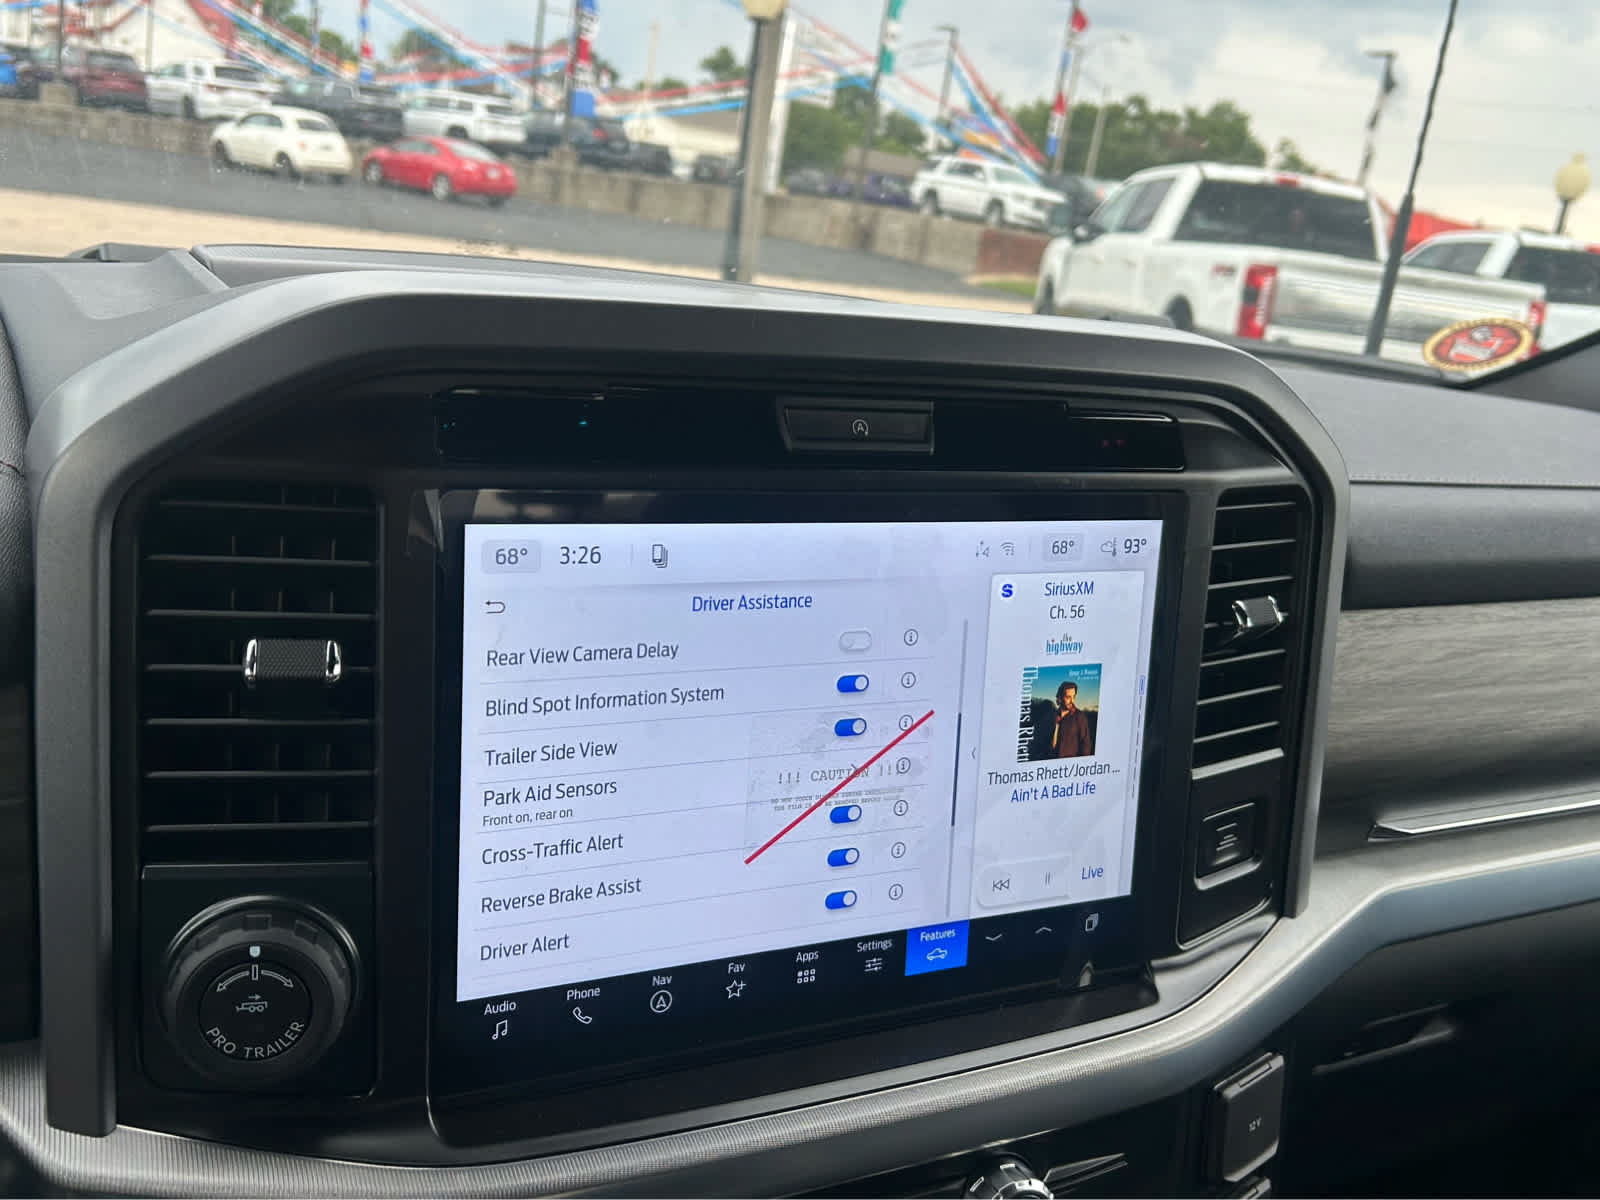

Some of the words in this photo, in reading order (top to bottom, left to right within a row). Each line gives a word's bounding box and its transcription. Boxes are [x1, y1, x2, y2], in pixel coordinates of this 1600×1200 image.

[1052, 540, 1075, 555] 68°
[1123, 538, 1147, 554] 93°
[495, 548, 529, 565] 68°
[559, 546, 602, 564] 3:26
[1044, 581, 1095, 597] SiriusXM
[692, 596, 735, 612] Driver
[737, 594, 813, 610] Assistance
[1049, 606, 1068, 619] Ch.
[1070, 604, 1085, 619] 56
[486, 650, 525, 667] Rear
[528, 648, 569, 664] View
[572, 644, 633, 662] Camera
[636, 642, 679, 660] Delay
[1046, 639, 1083, 655] highway
[485, 699, 528, 717] Blind
[531, 695, 571, 716] Spot
[574, 689, 667, 710] Information
[670, 686, 725, 706] System
[485, 748, 537, 767] Trailer
[540, 745, 576, 761] Side
[579, 741, 618, 758] View
[810, 768, 869, 782] CAUTIN
[987, 769, 1034, 785] Thomas
[483, 788, 521, 807] Park
[524, 784, 552, 802] Aid
[555, 780, 618, 799] Sensors
[1010, 787, 1039, 803] Ain't
[1041, 786, 1050, 800] A
[1052, 783, 1074, 798] Bad
[1076, 781, 1096, 796] Life
[482, 813, 513, 827] Front
[515, 811, 533, 825] on,
[535, 809, 557, 822] rear
[559, 807, 574, 819] on
[481, 838, 584, 865] Cross-Traffic
[586, 833, 625, 851] Alert
[1081, 866, 1104, 880] Live
[481, 892, 546, 913] Reverse
[549, 885, 594, 904] Brake
[596, 878, 642, 899] Assist
[920, 928, 956, 942] Features
[480, 942, 529, 961] Driver
[531, 934, 571, 954] Alert
[856, 937, 893, 954] Settings
[796, 949, 819, 964] Apps
[727, 962, 746, 974] Fav
[652, 974, 673, 986] Nav
[566, 986, 601, 1000] Phone
[484, 1000, 517, 1015] Audio
[206, 1027, 237, 1055] PRO
[244, 1021, 305, 1060] TRAILER
